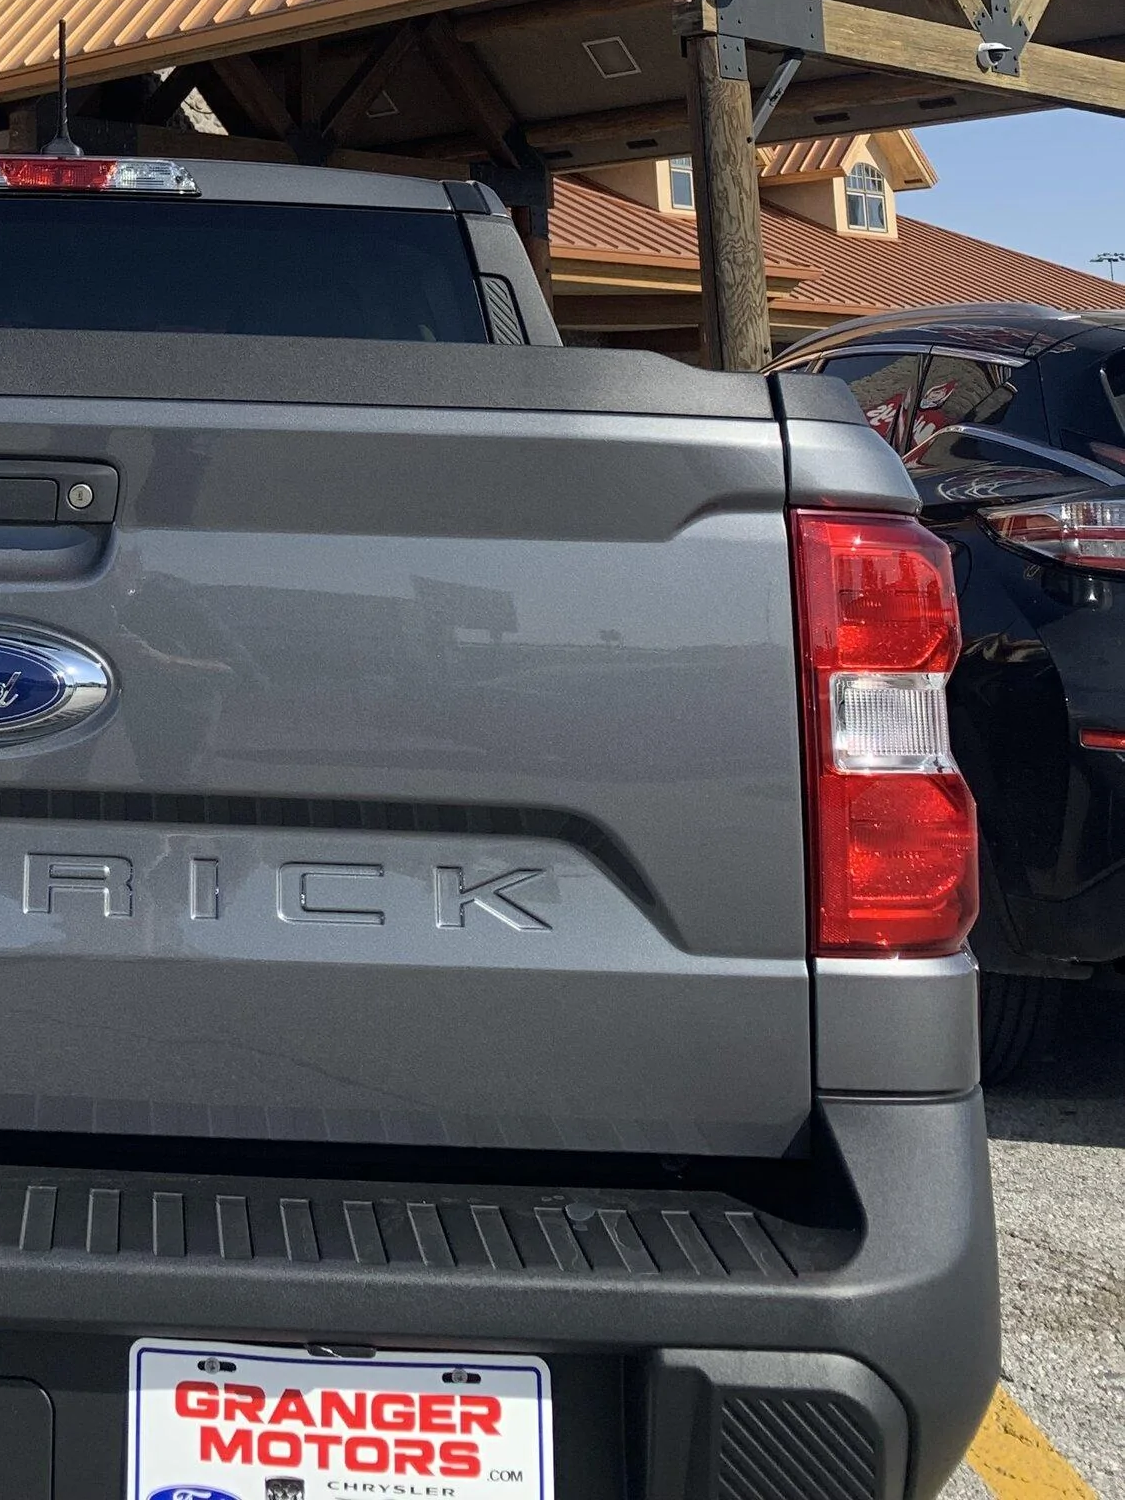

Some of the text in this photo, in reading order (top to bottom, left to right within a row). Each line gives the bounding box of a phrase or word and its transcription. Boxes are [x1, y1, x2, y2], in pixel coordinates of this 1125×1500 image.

[174, 1380, 503, 1437] GRANGER
[198, 1425, 524, 1483] MOTORS .COM
[326, 1480, 457, 1498] CHRYSLER
